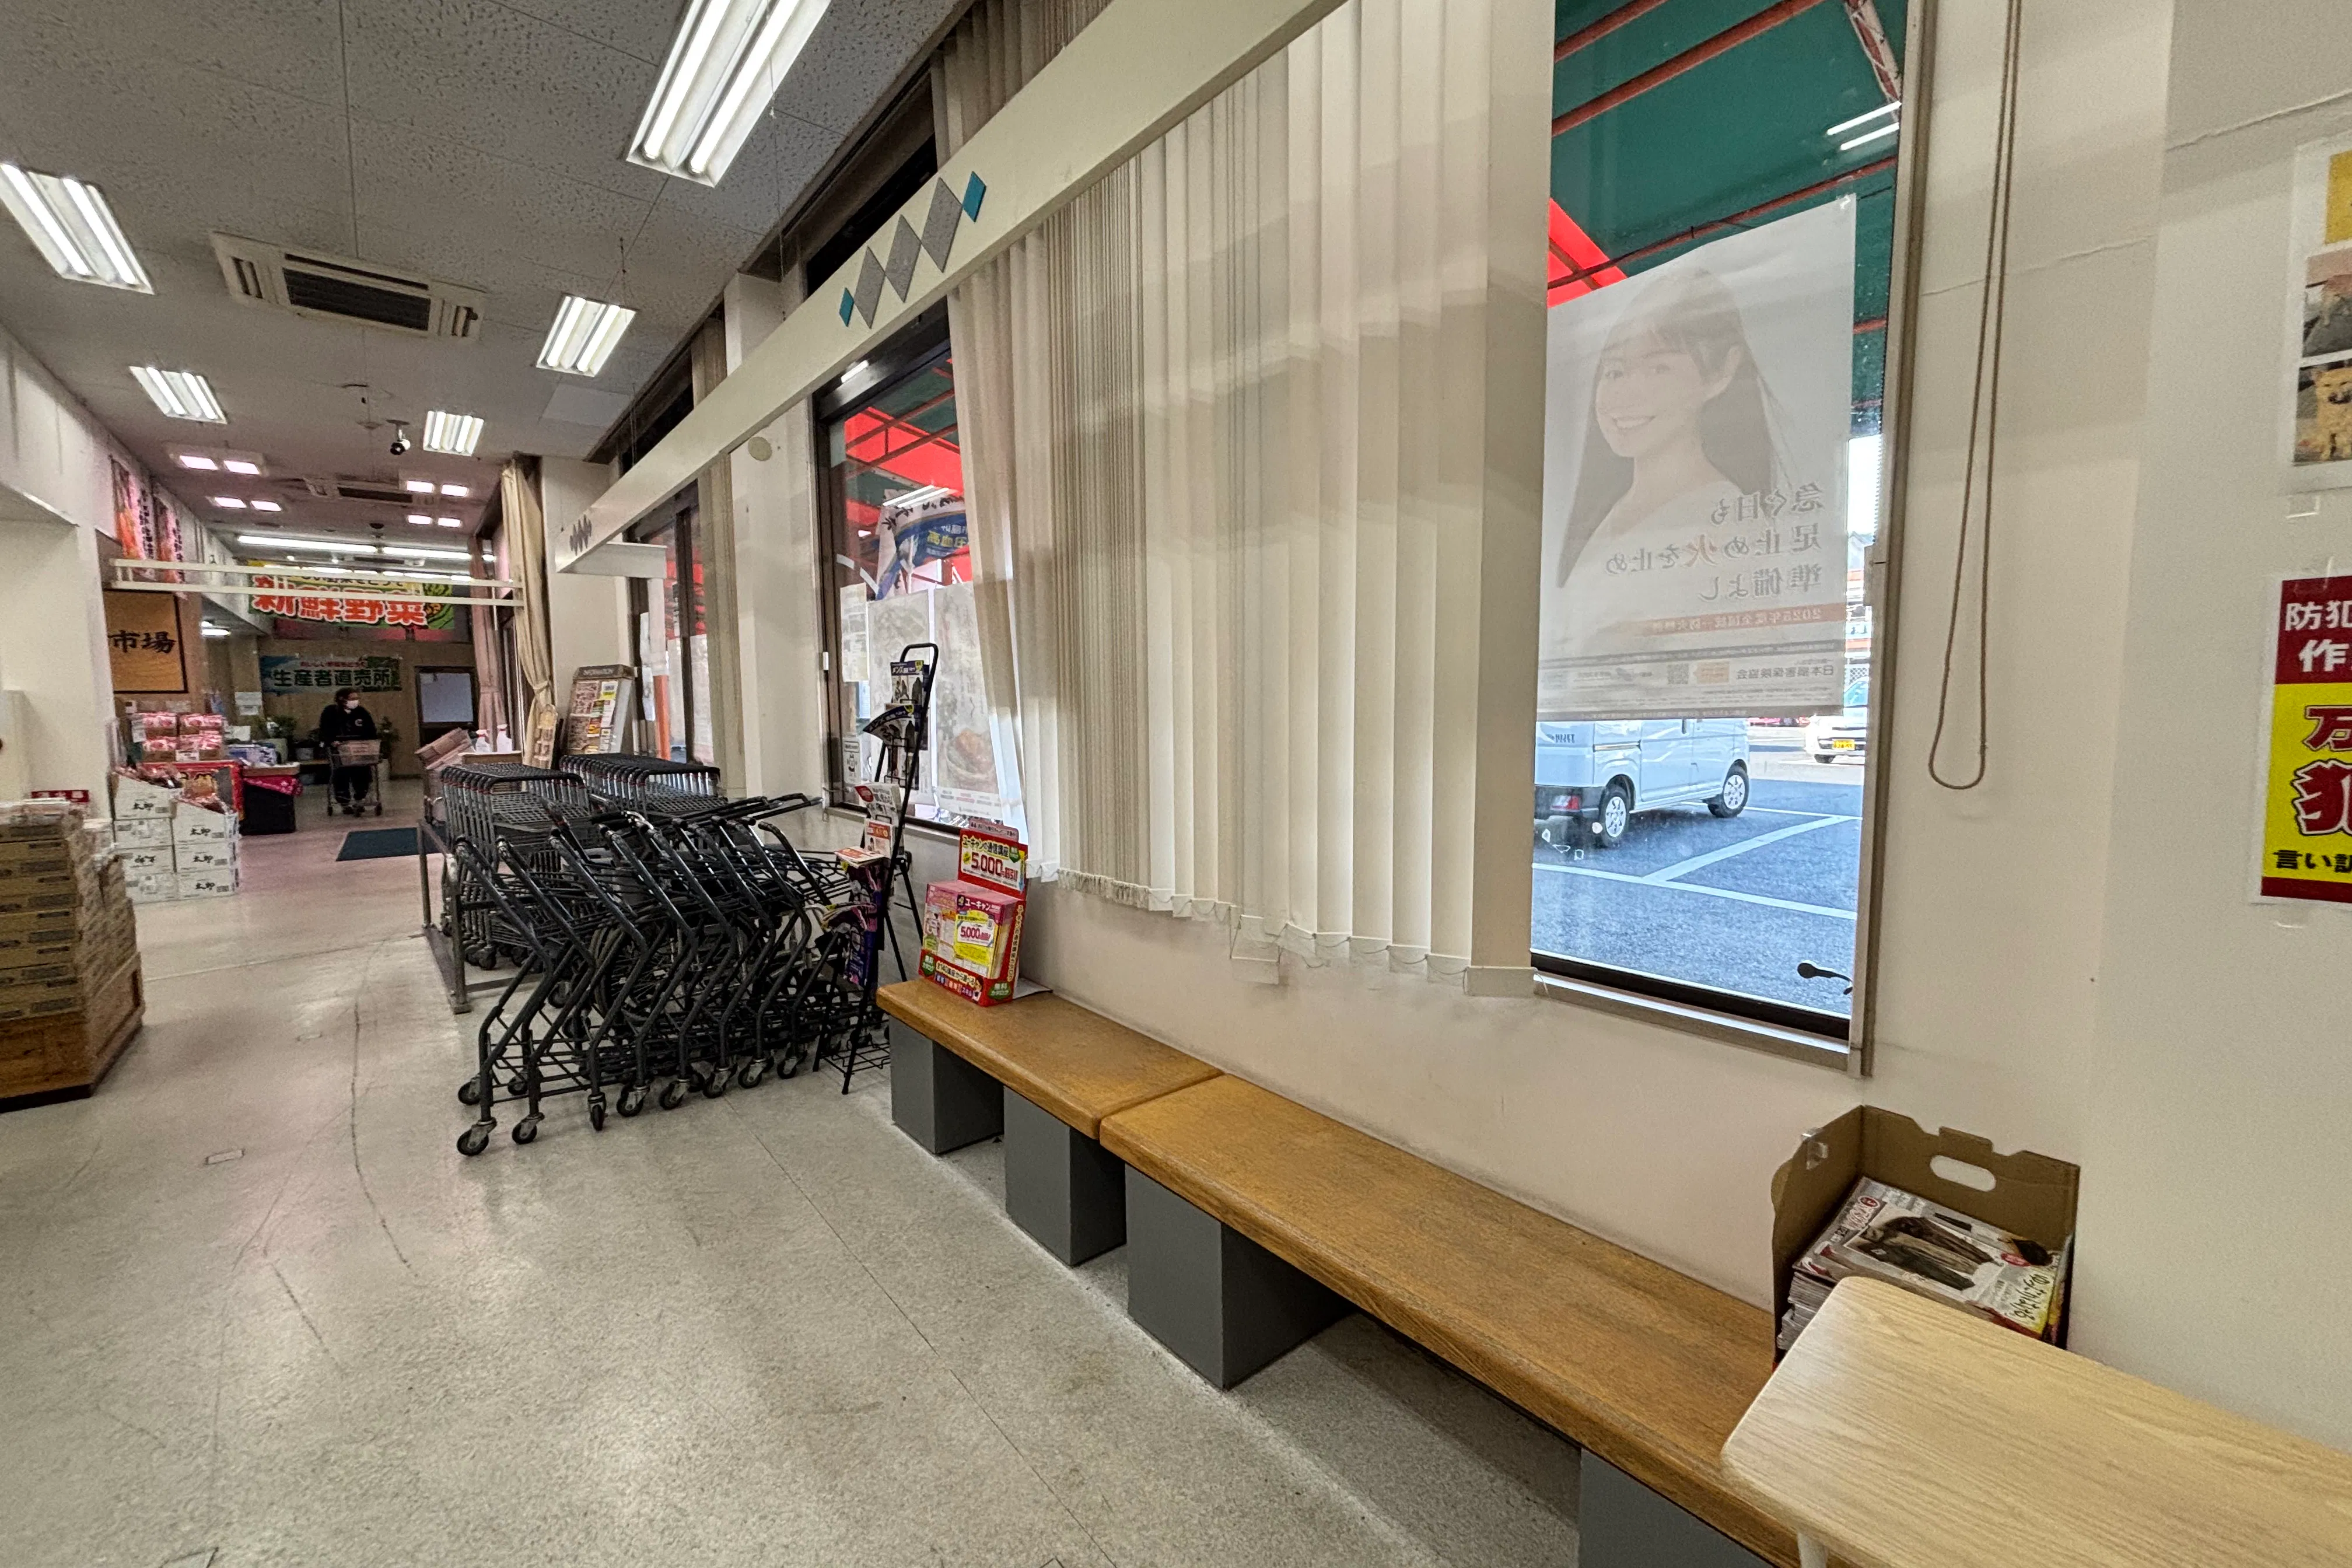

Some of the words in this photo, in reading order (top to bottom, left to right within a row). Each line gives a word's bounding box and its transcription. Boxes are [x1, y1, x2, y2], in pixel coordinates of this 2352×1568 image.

[251, 575, 428, 625] 新鮮野菜
[108, 630, 176, 653] 市場
[273, 668, 392, 687] 生産者直売所
[965, 898, 991, 912] ユーキャン
